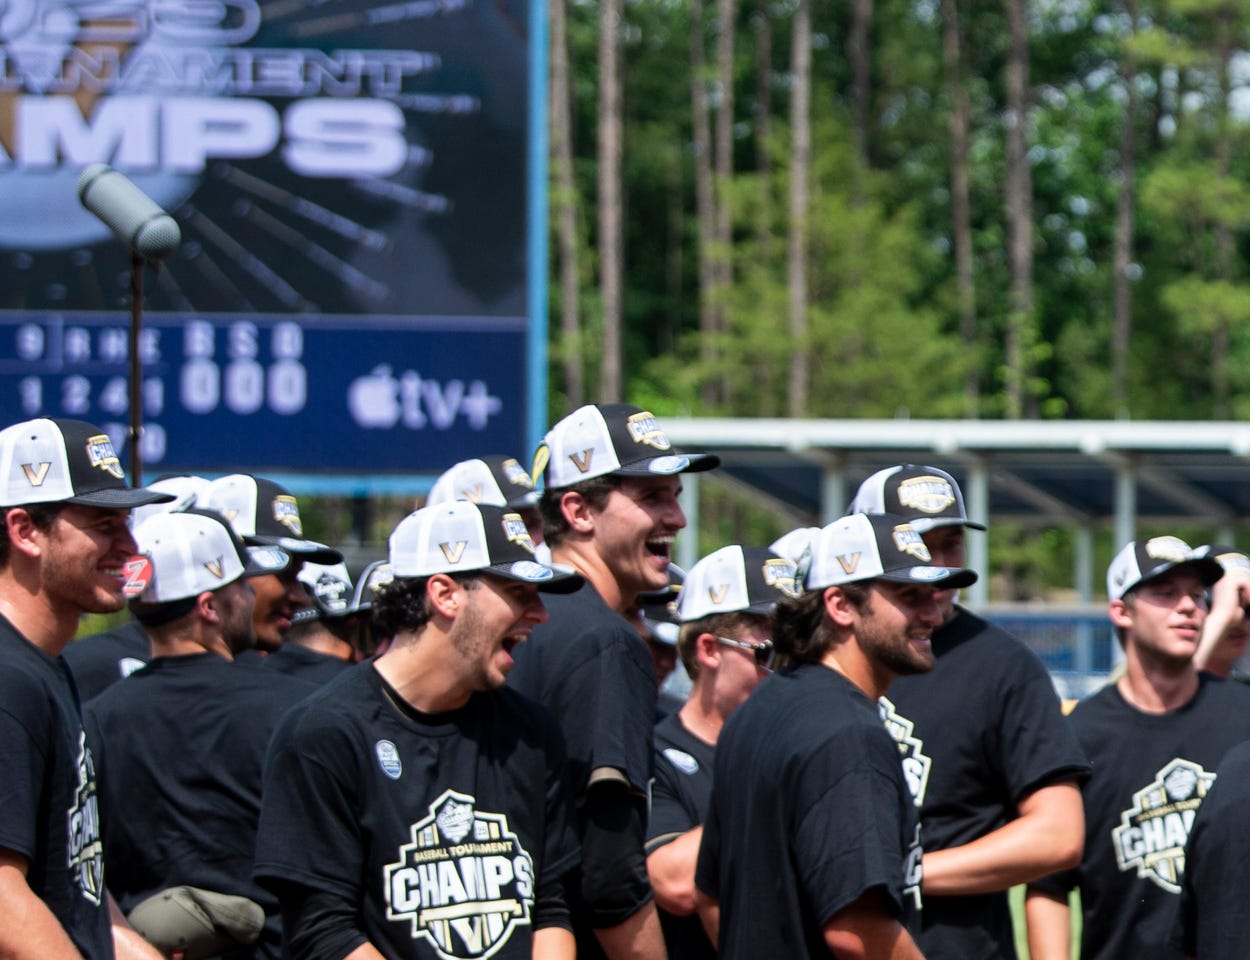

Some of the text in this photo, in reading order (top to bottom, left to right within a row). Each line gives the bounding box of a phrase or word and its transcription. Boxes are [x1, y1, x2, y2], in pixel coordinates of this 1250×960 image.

[0, 96, 407, 177] MPS
[229, 320, 258, 359] S
[569, 449, 593, 473] V
[22, 462, 51, 486] V
[440, 540, 467, 564] V
[836, 552, 862, 574] V
[204, 556, 224, 579] V
[709, 584, 730, 604] V
